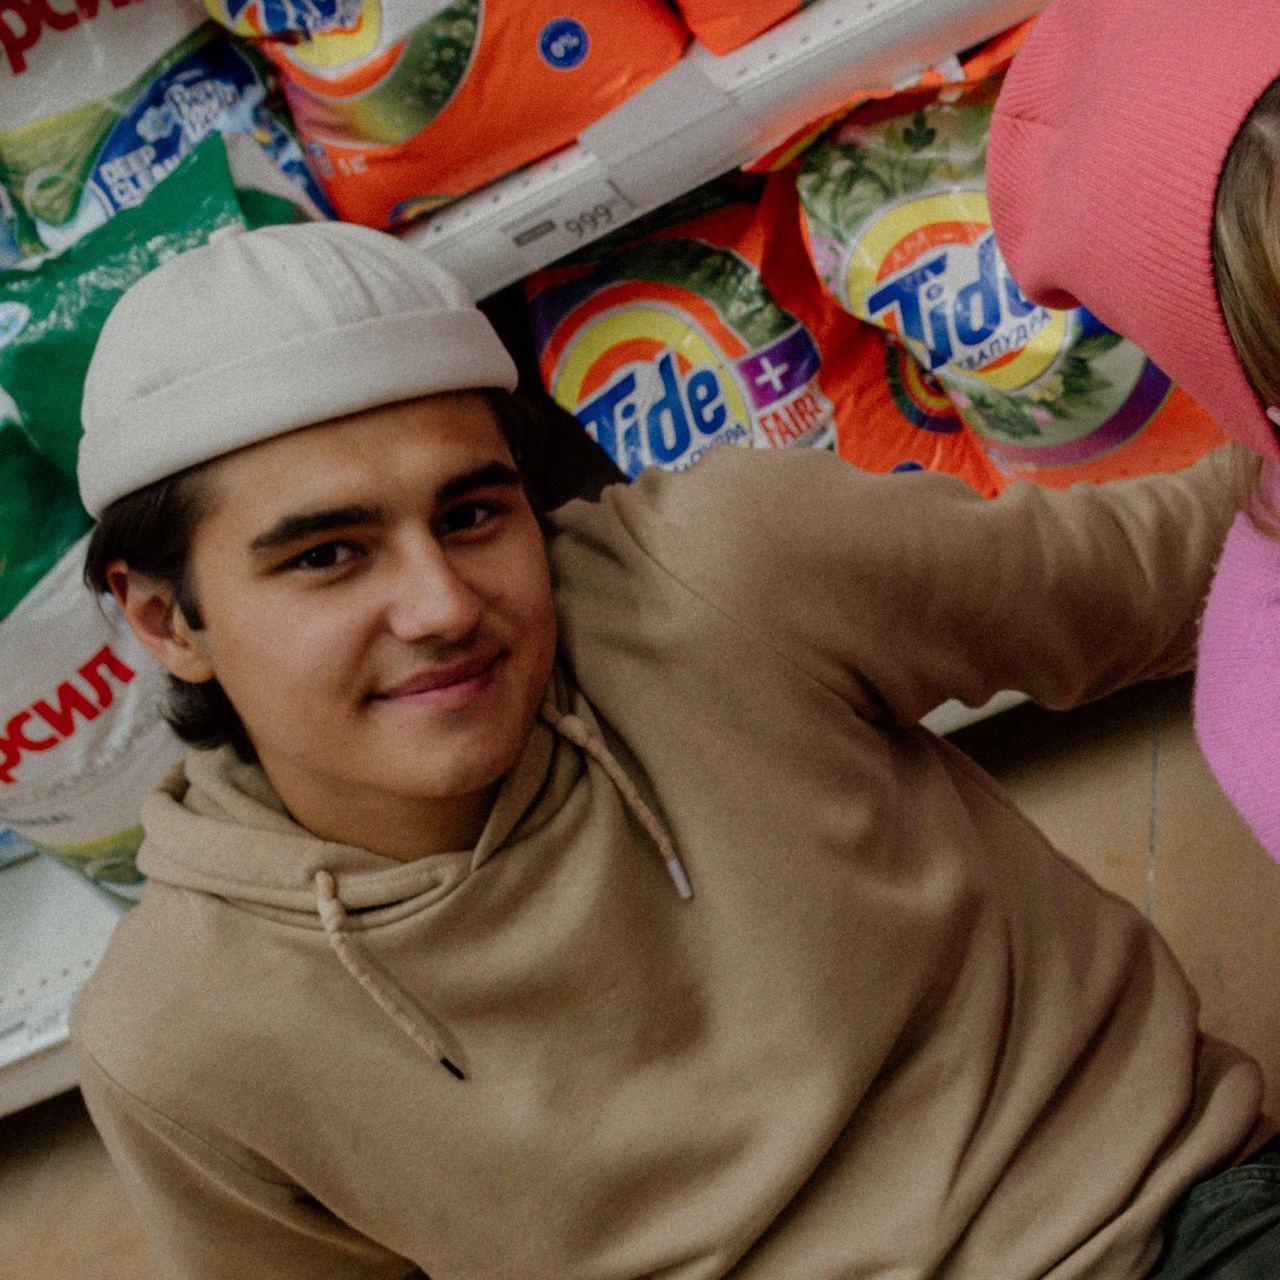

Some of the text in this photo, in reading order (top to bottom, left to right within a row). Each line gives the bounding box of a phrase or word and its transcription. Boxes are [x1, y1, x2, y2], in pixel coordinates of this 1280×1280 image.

[100, 145, 155, 183] DEEP
[565, 204, 613, 238] 999
[576, 352, 727, 484] Tide
